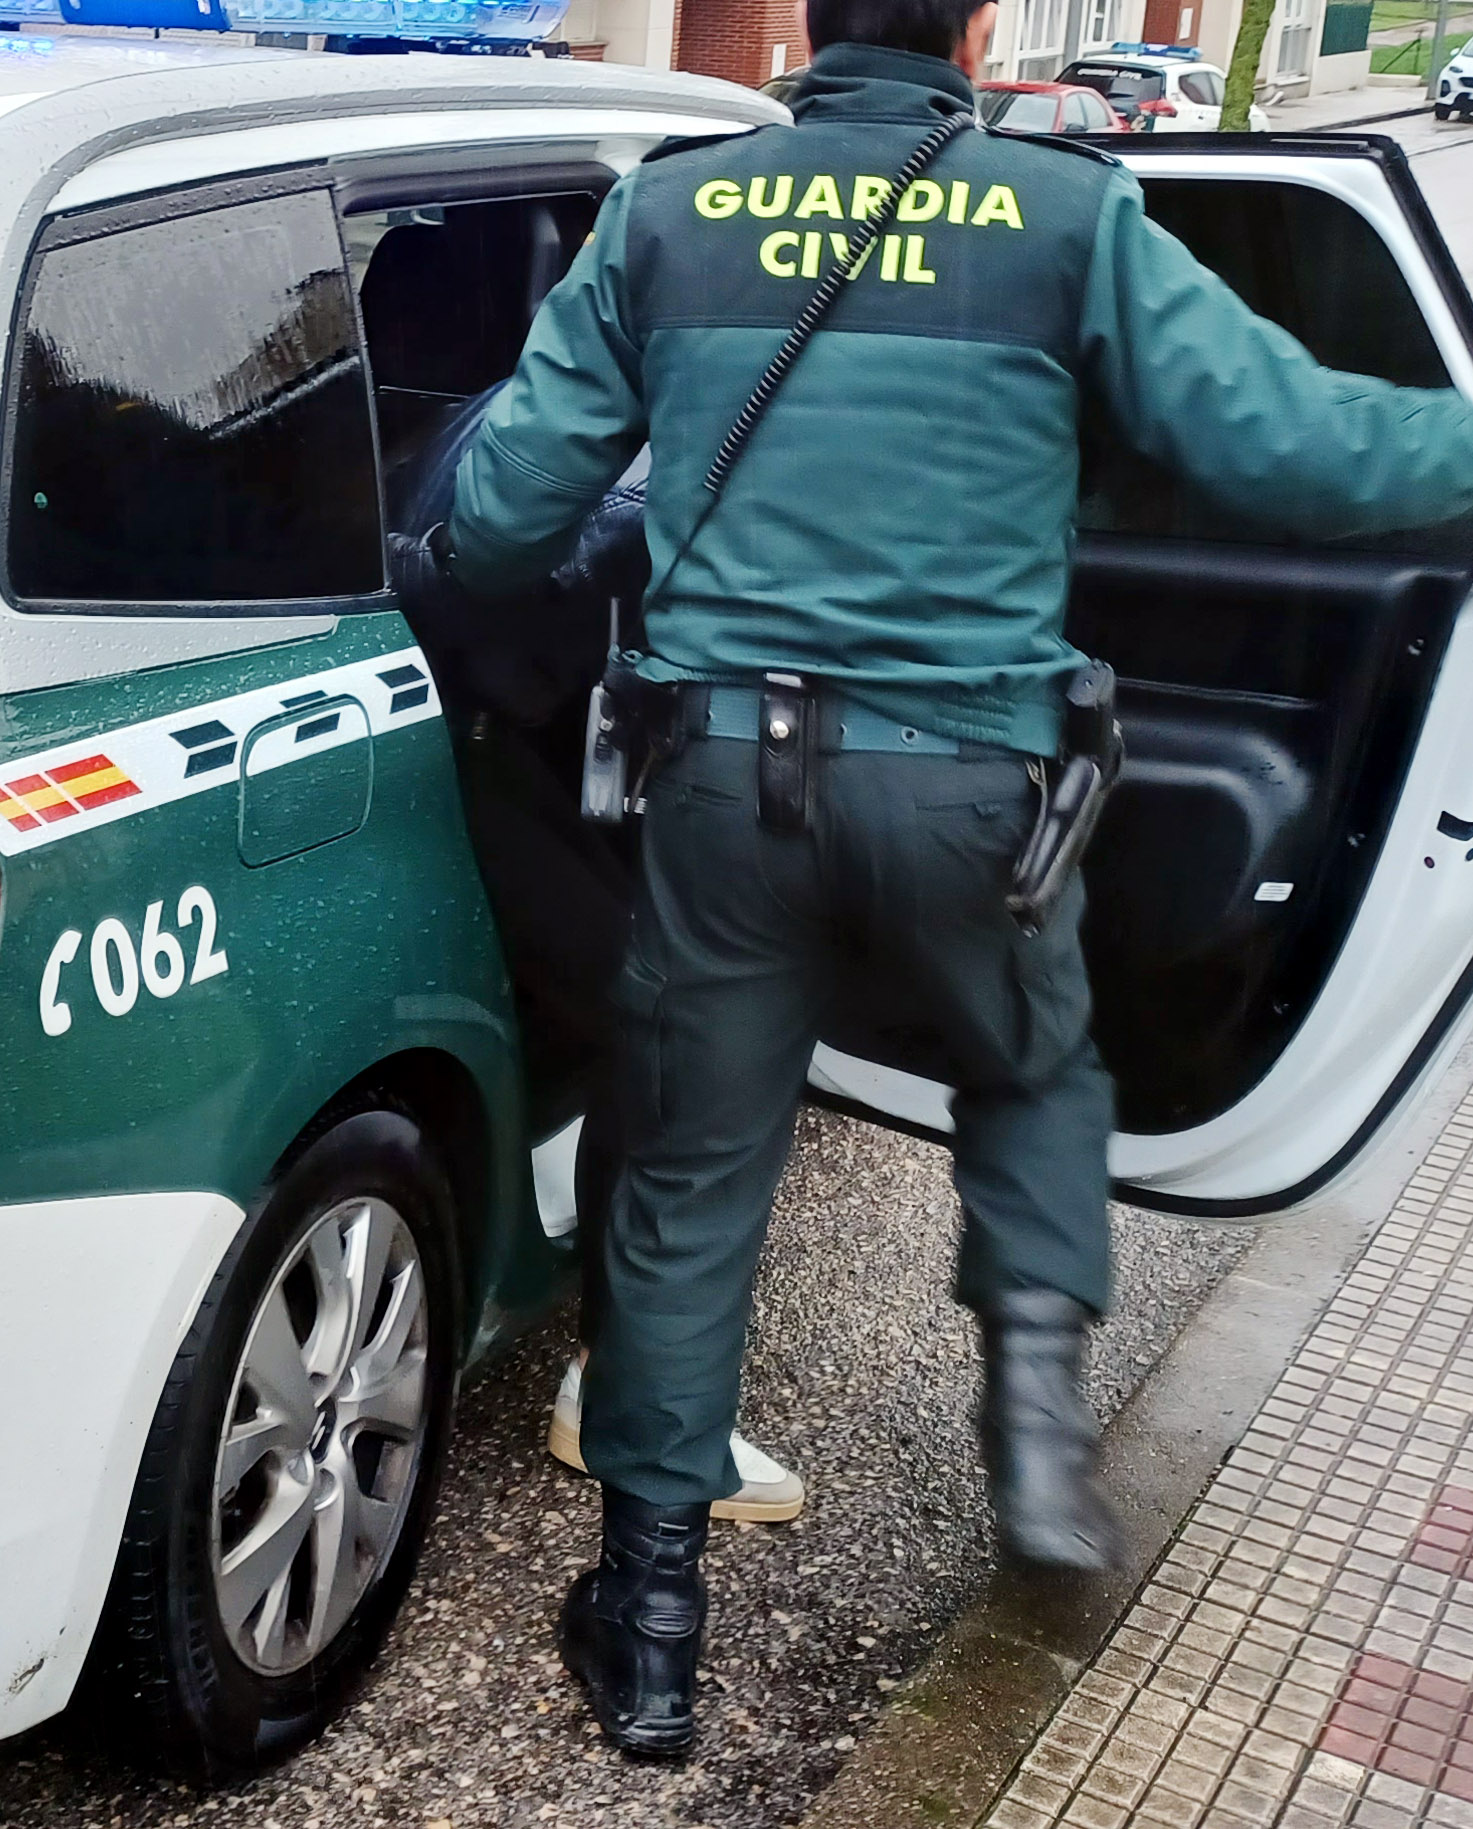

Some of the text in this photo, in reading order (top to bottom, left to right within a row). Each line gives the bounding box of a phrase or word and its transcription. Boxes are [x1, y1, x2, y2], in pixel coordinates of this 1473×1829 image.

[694, 175, 1024, 230] GUARDIA
[759, 230, 936, 284] CIVIL
[90, 885, 229, 1016] 062
